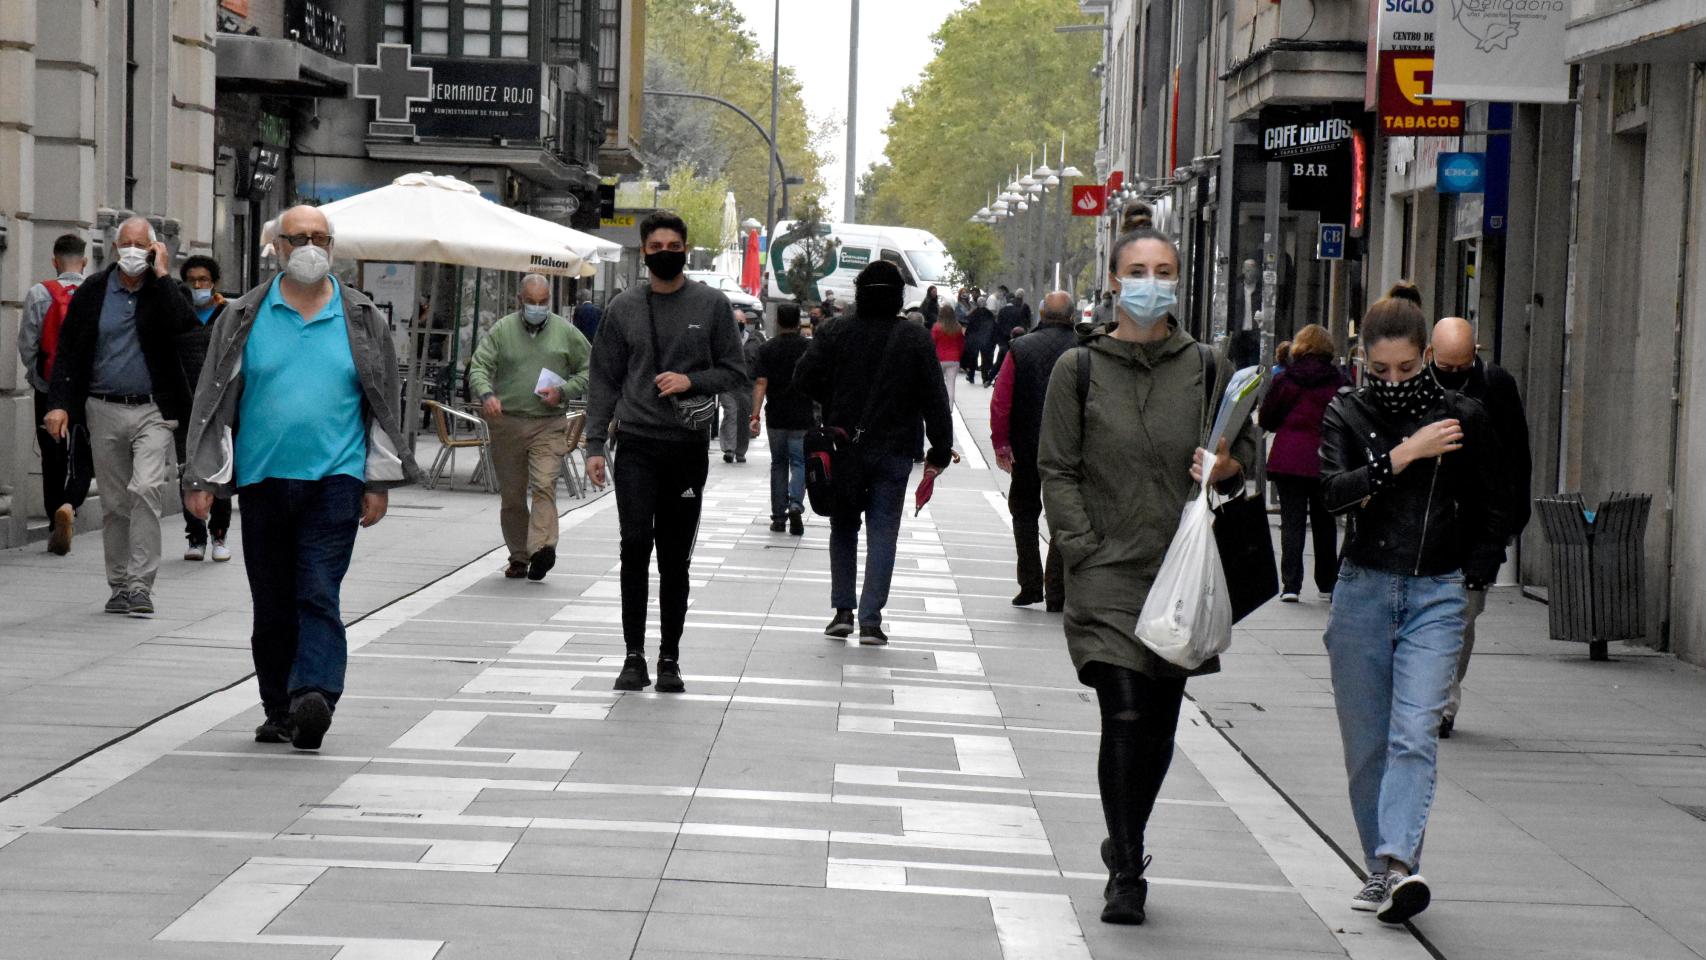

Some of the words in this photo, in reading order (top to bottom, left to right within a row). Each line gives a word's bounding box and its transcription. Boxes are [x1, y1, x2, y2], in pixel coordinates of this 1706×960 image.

[1385, 0, 1434, 13] SIGLO
[1393, 31, 1421, 41] CENTRO
[503, 86, 533, 104] ROJO
[1383, 115, 1460, 128] TABACOS
[1264, 124, 1298, 150] CAFE
[1293, 163, 1328, 177] BAR
[530, 254, 569, 269] Mahou
